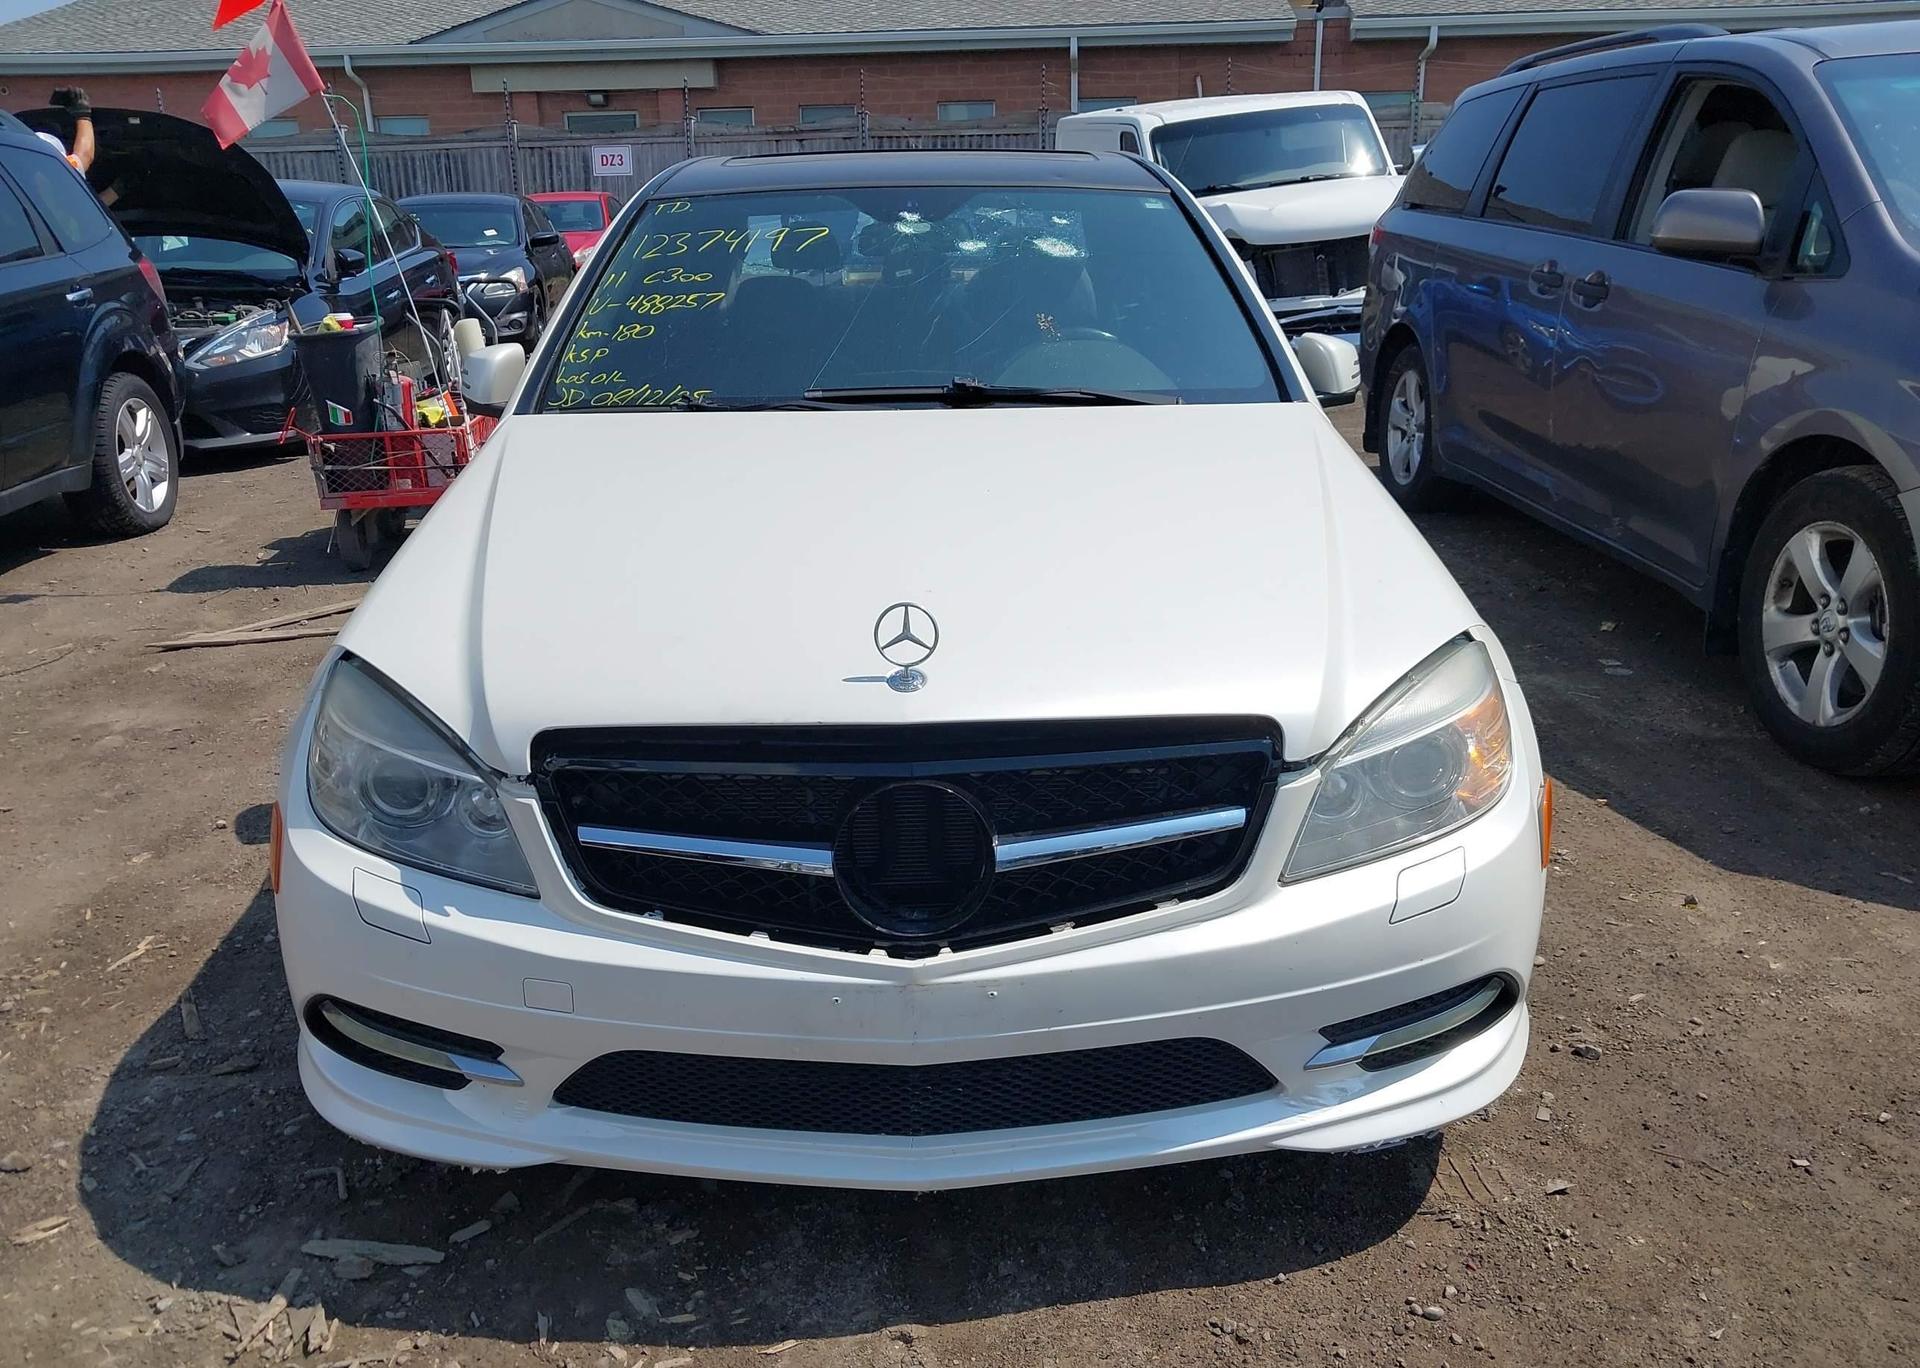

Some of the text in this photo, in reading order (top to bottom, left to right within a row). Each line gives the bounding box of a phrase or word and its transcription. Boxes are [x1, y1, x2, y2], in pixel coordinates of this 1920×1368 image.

[600, 153, 625, 168] DZ3
[632, 226, 830, 260] 12374197
[602, 271, 628, 289] 11
